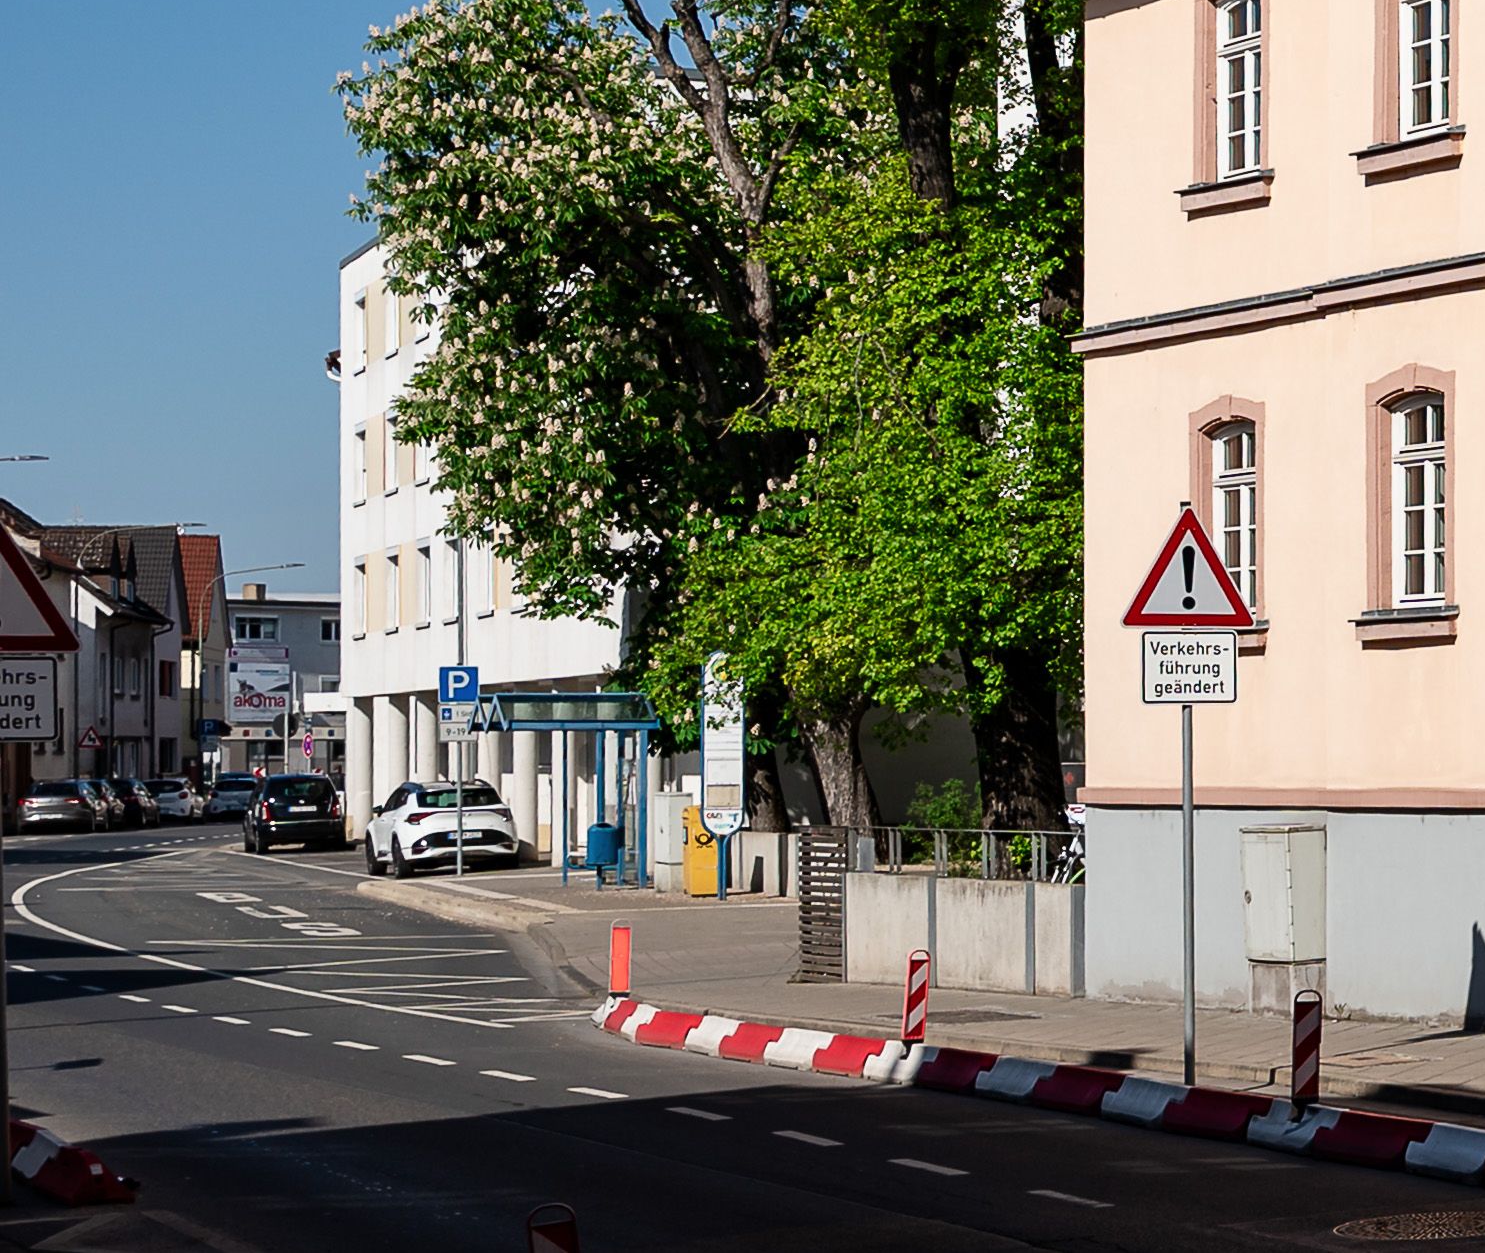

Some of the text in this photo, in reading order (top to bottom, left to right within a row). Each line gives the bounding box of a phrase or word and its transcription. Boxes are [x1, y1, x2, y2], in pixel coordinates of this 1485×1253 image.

[1150, 640, 1230, 656] Verkehrs-
[0, 668, 48, 685] hrs-
[1159, 660, 1221, 678] führung
[448, 670, 470, 699] P
[1154, 679, 1225, 697] geändert
[195, 892, 363, 937] BUS
